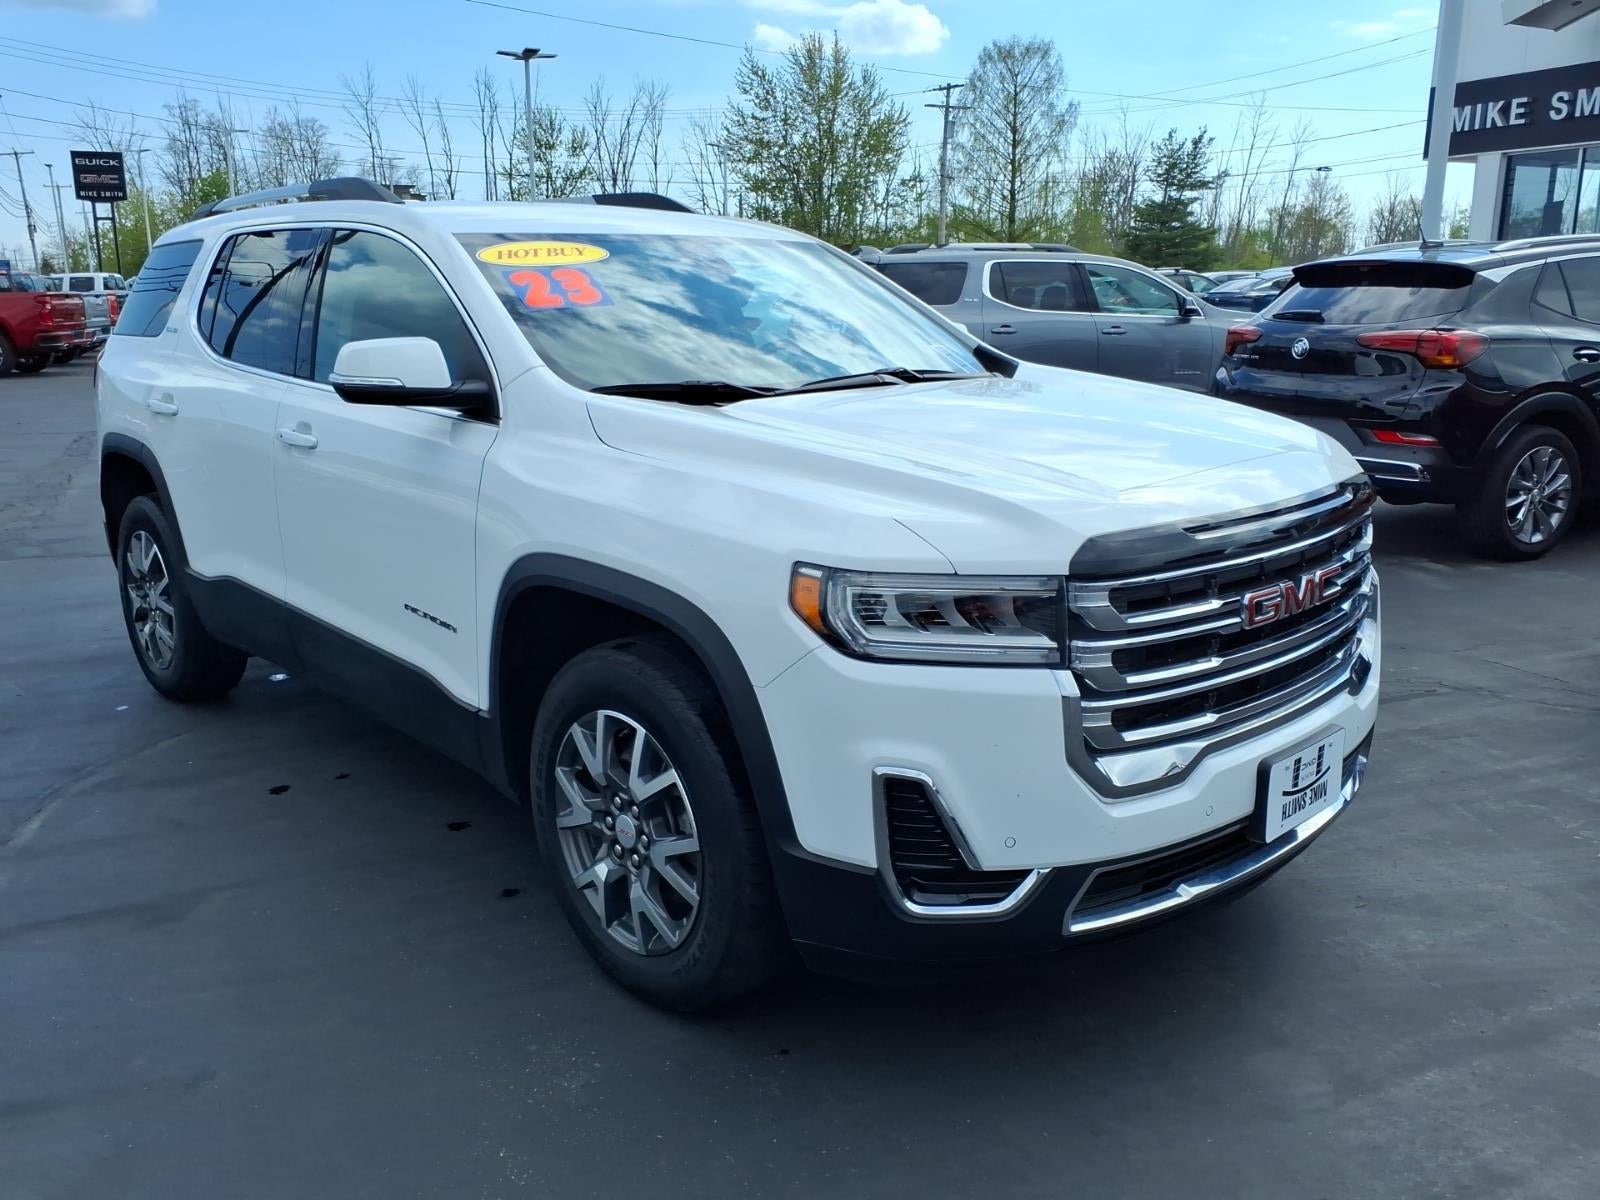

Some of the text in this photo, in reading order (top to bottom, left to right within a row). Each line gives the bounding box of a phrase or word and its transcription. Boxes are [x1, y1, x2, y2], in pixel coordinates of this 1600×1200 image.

[1452, 97, 1530, 132] MIKE
[75, 158, 120, 166] BUICK
[80, 174, 119, 183] GMC
[497, 247, 586, 260] HOT BUY
[509, 268, 602, 309] 23
[1241, 566, 1342, 630] GMC
[1282, 779, 1328, 822] MIKE SMITH
